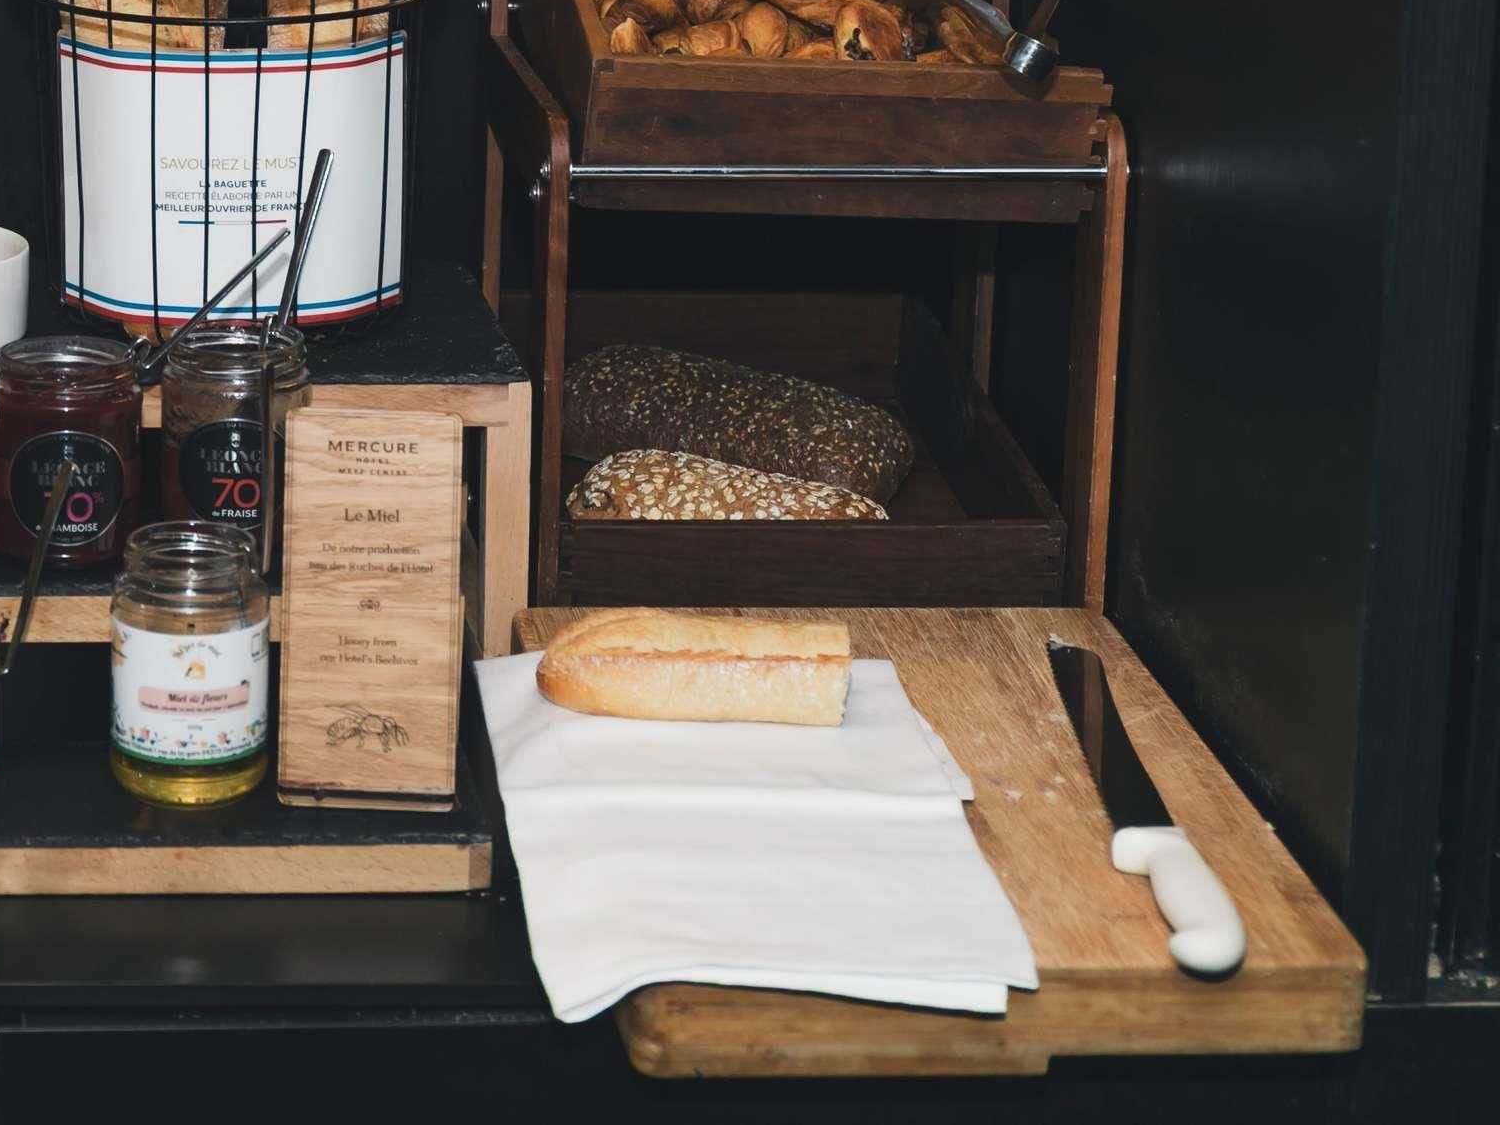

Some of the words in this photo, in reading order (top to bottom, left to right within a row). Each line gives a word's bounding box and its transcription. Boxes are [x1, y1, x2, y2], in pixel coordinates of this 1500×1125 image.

[211, 190, 262, 201] ÉLABORE
[264, 191, 282, 199] PAR
[156, 203, 205, 212] MEILLEUR
[208, 205, 252, 213] OUVRIER
[255, 204, 268, 212] DE
[271, 203, 303, 211] FRAN
[328, 440, 419, 455] MERCURE
[212, 477, 261, 508] 70
[221, 509, 258, 518] FRAISE
[344, 508, 364, 523] Le
[367, 508, 400, 523] Miel
[51, 523, 98, 533] AMBOISE
[322, 543, 336, 553] De
[339, 545, 365, 553] notre
[368, 544, 420, 557] production
[168, 693, 187, 703] Miel
[189, 693, 200, 703] de
[201, 692, 228, 705] fleurs
